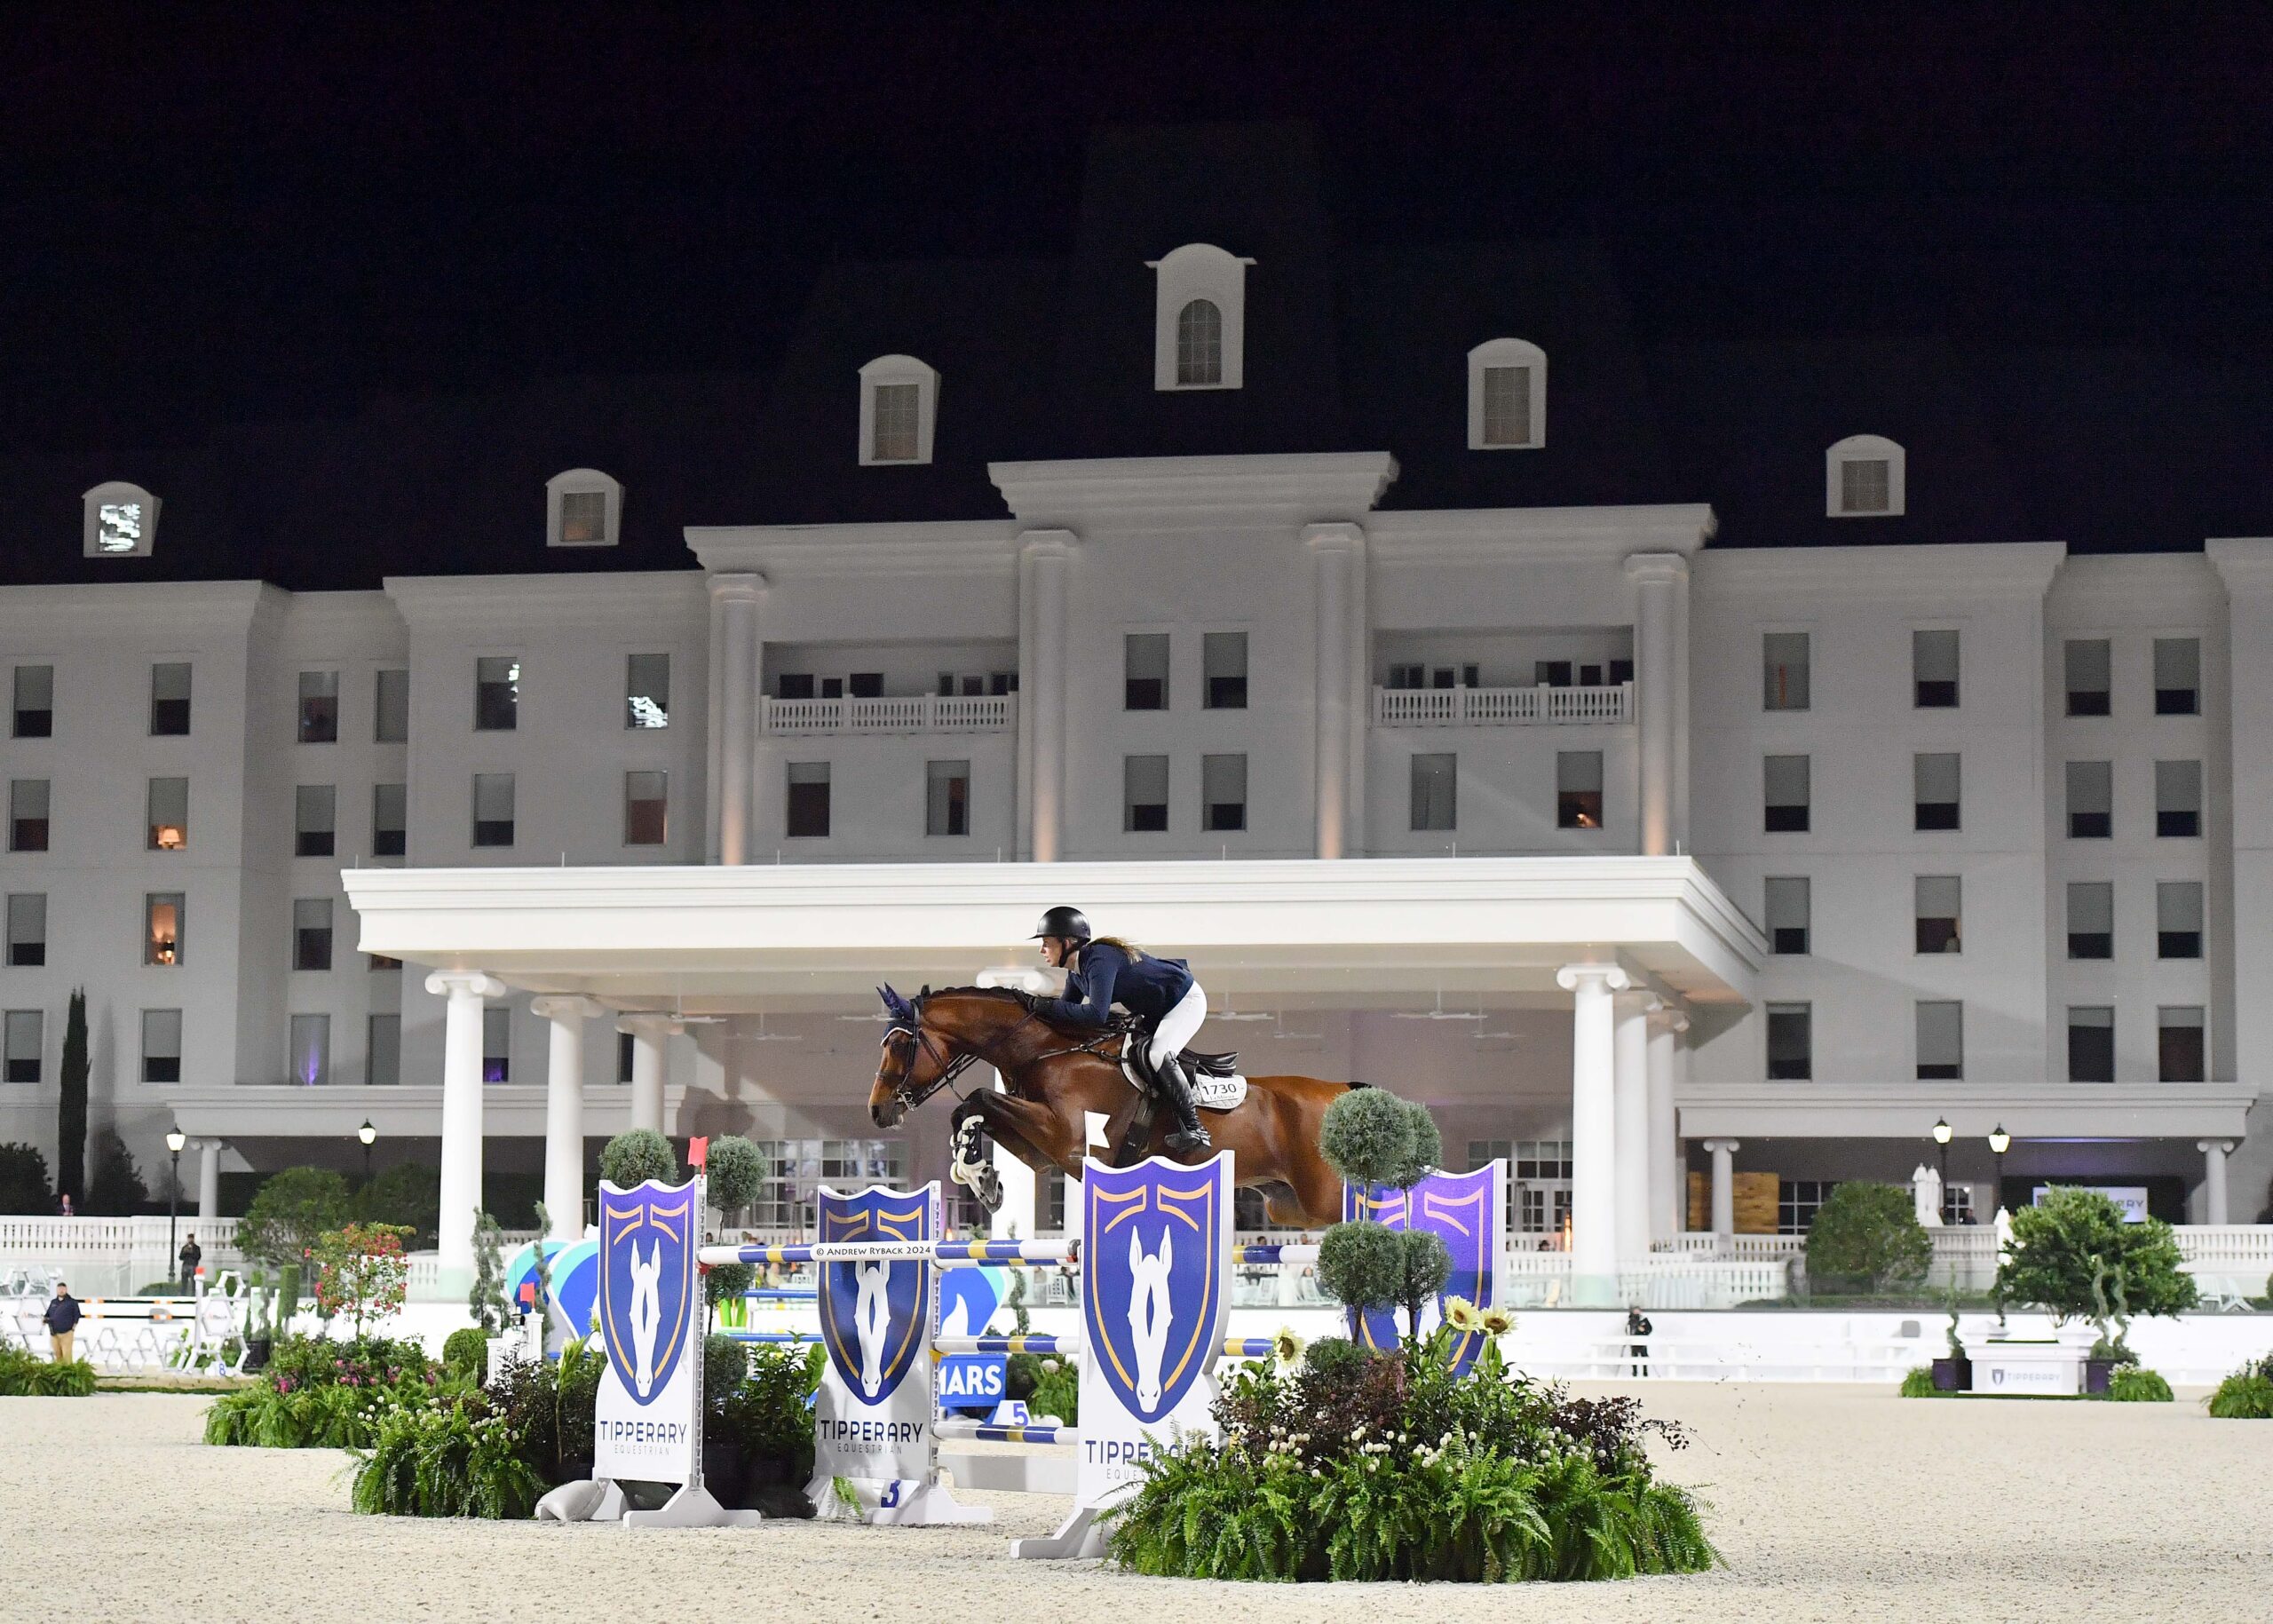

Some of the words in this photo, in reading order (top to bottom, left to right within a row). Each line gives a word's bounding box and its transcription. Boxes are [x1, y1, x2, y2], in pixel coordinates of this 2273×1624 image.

[1202, 1083, 1237, 1095] 1730
[218, 1363, 226, 1376] 8
[1013, 1403, 1029, 1427] 5
[600, 1421, 687, 1445] TIPPERARY
[820, 1420, 923, 1444] TIPPERARY
[614, 1444, 669, 1455] EQUESTRIAN
[837, 1442, 902, 1454] EQUESTRIAN
